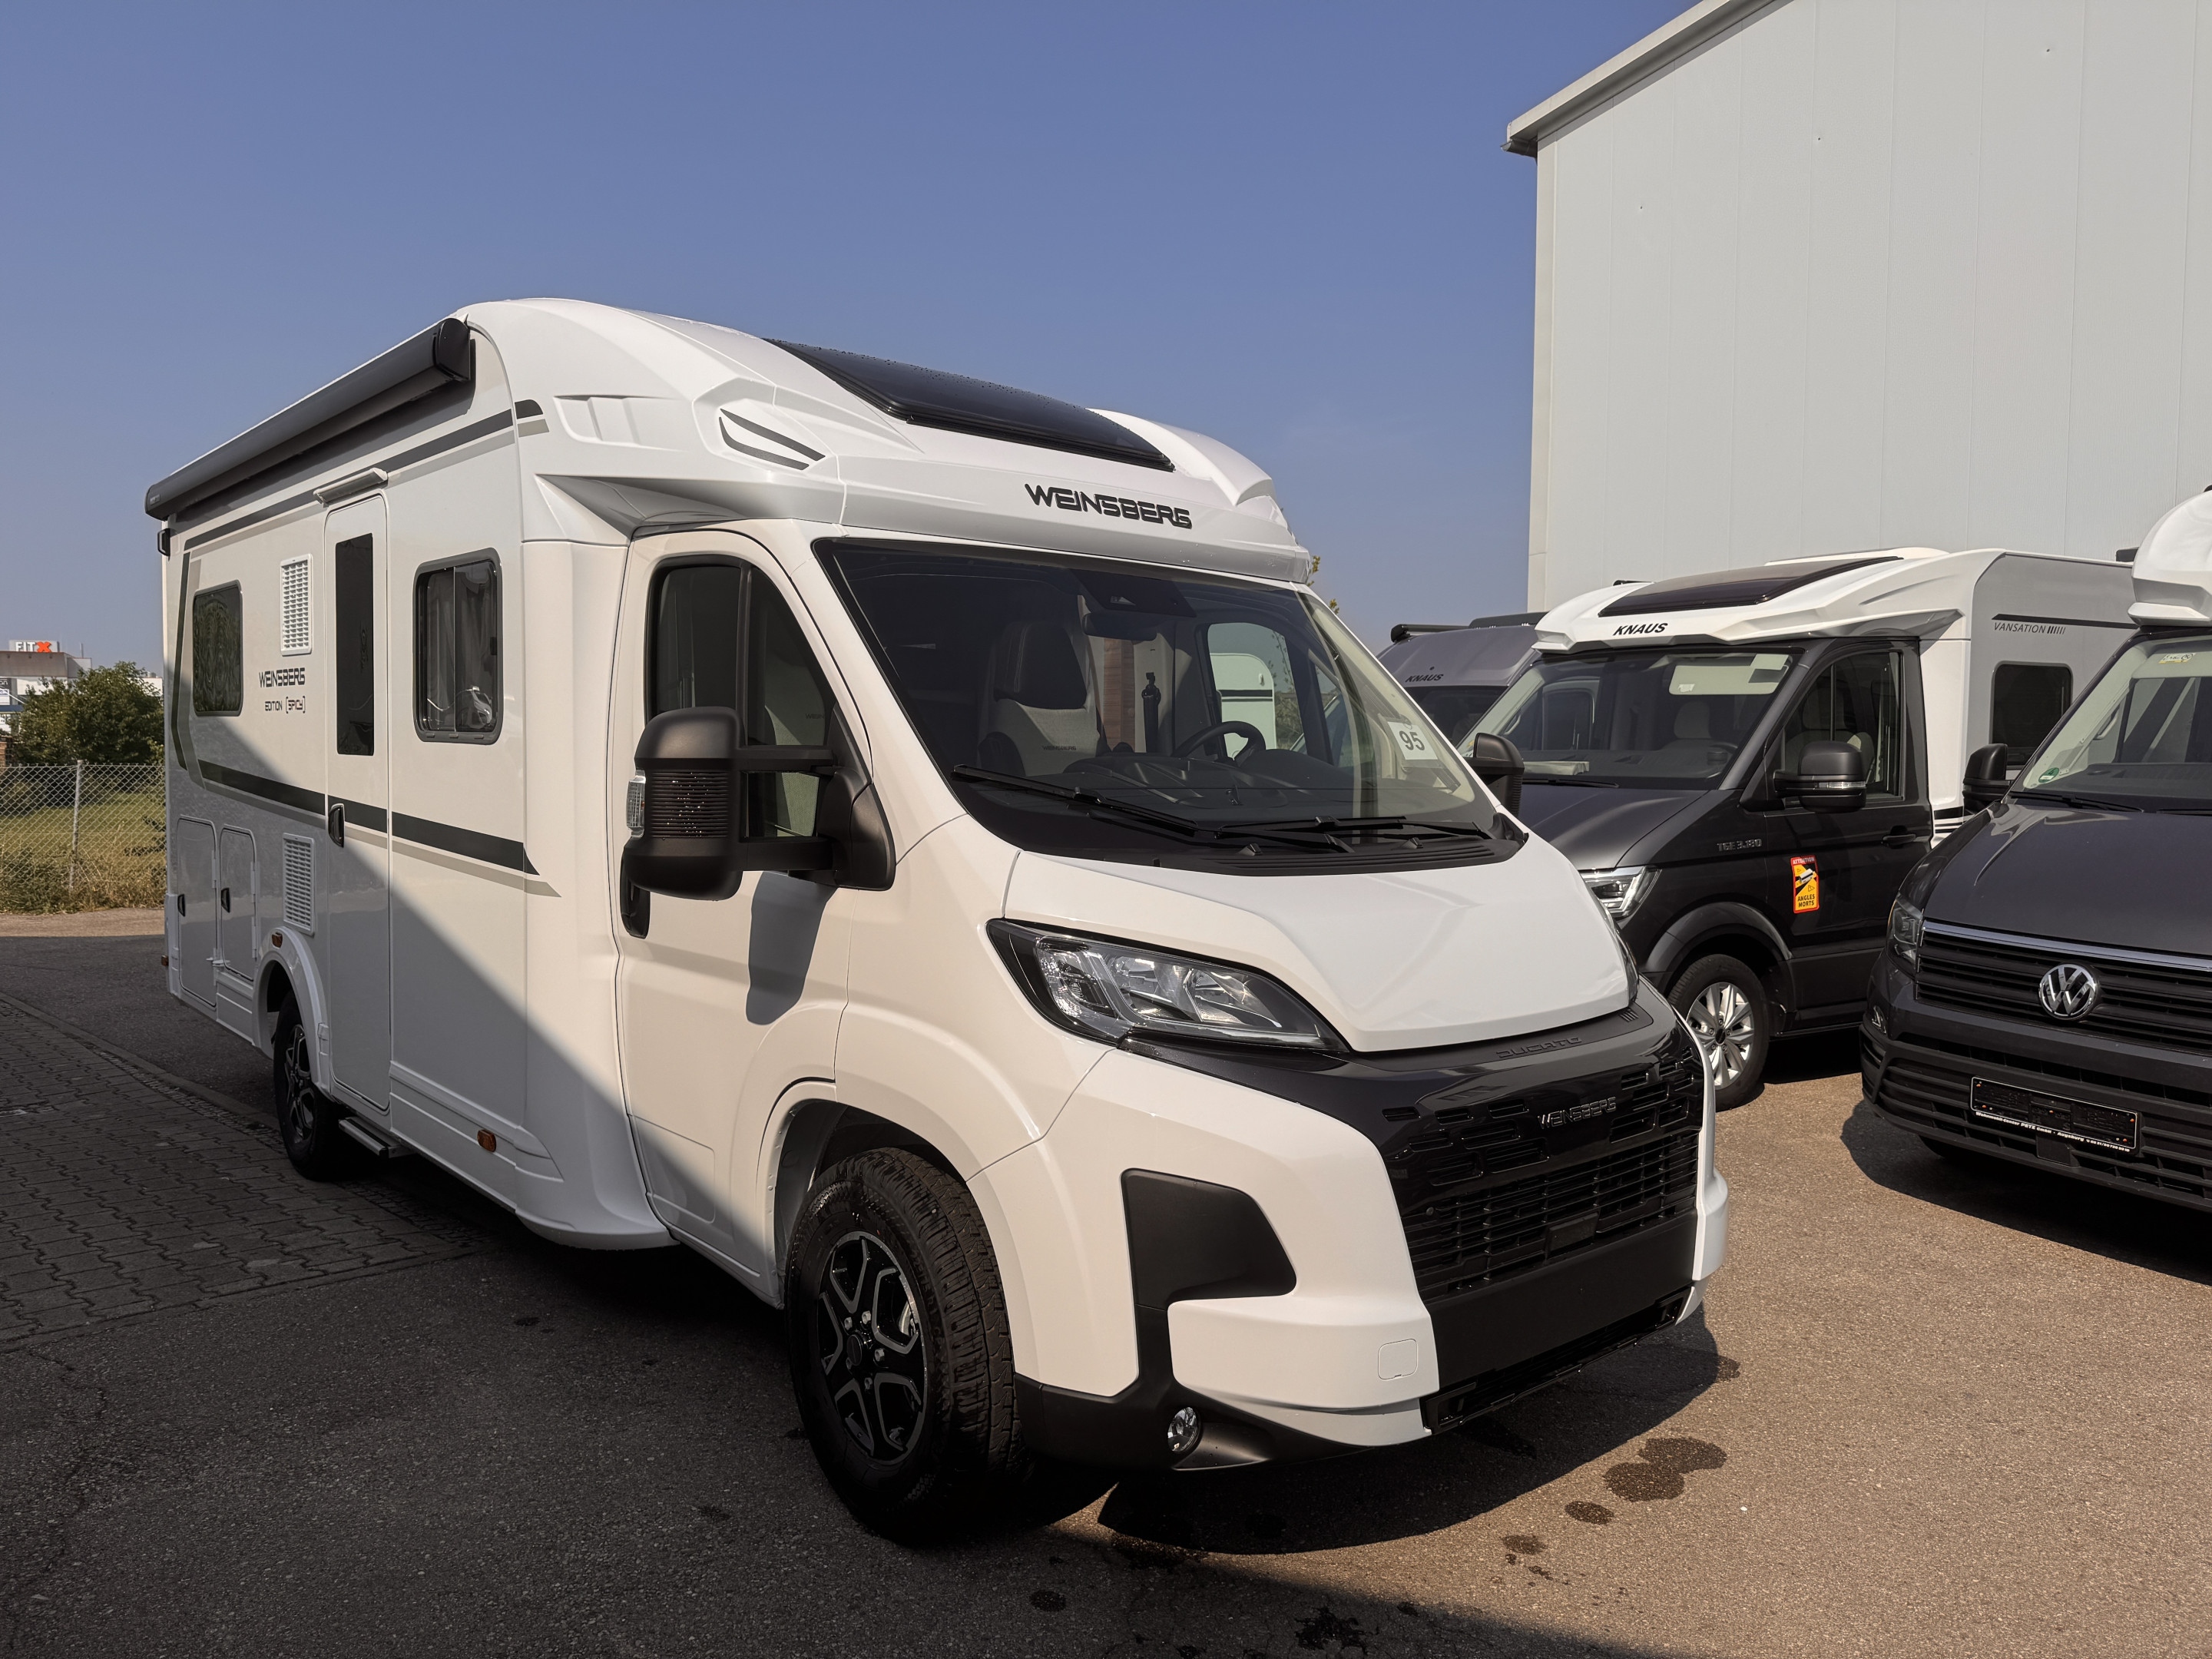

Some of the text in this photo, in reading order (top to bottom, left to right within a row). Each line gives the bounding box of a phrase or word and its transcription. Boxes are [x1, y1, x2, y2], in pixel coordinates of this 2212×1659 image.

[1025, 483, 1192, 530] WEINSBERG
[1612, 623, 1668, 636] KNAUS
[1994, 622, 2046, 634] VANSATION
[258, 667, 306, 687] WEINSBERG
[1405, 674, 1444, 683] KNAUS
[264, 700, 283, 711] EDITION
[1399, 730, 1426, 751] 95
[1496, 1037, 1583, 1058] DUCATO
[1538, 1096, 1617, 1129] WEINSBERG
[2057, 1131, 2085, 1142] Augsburg
